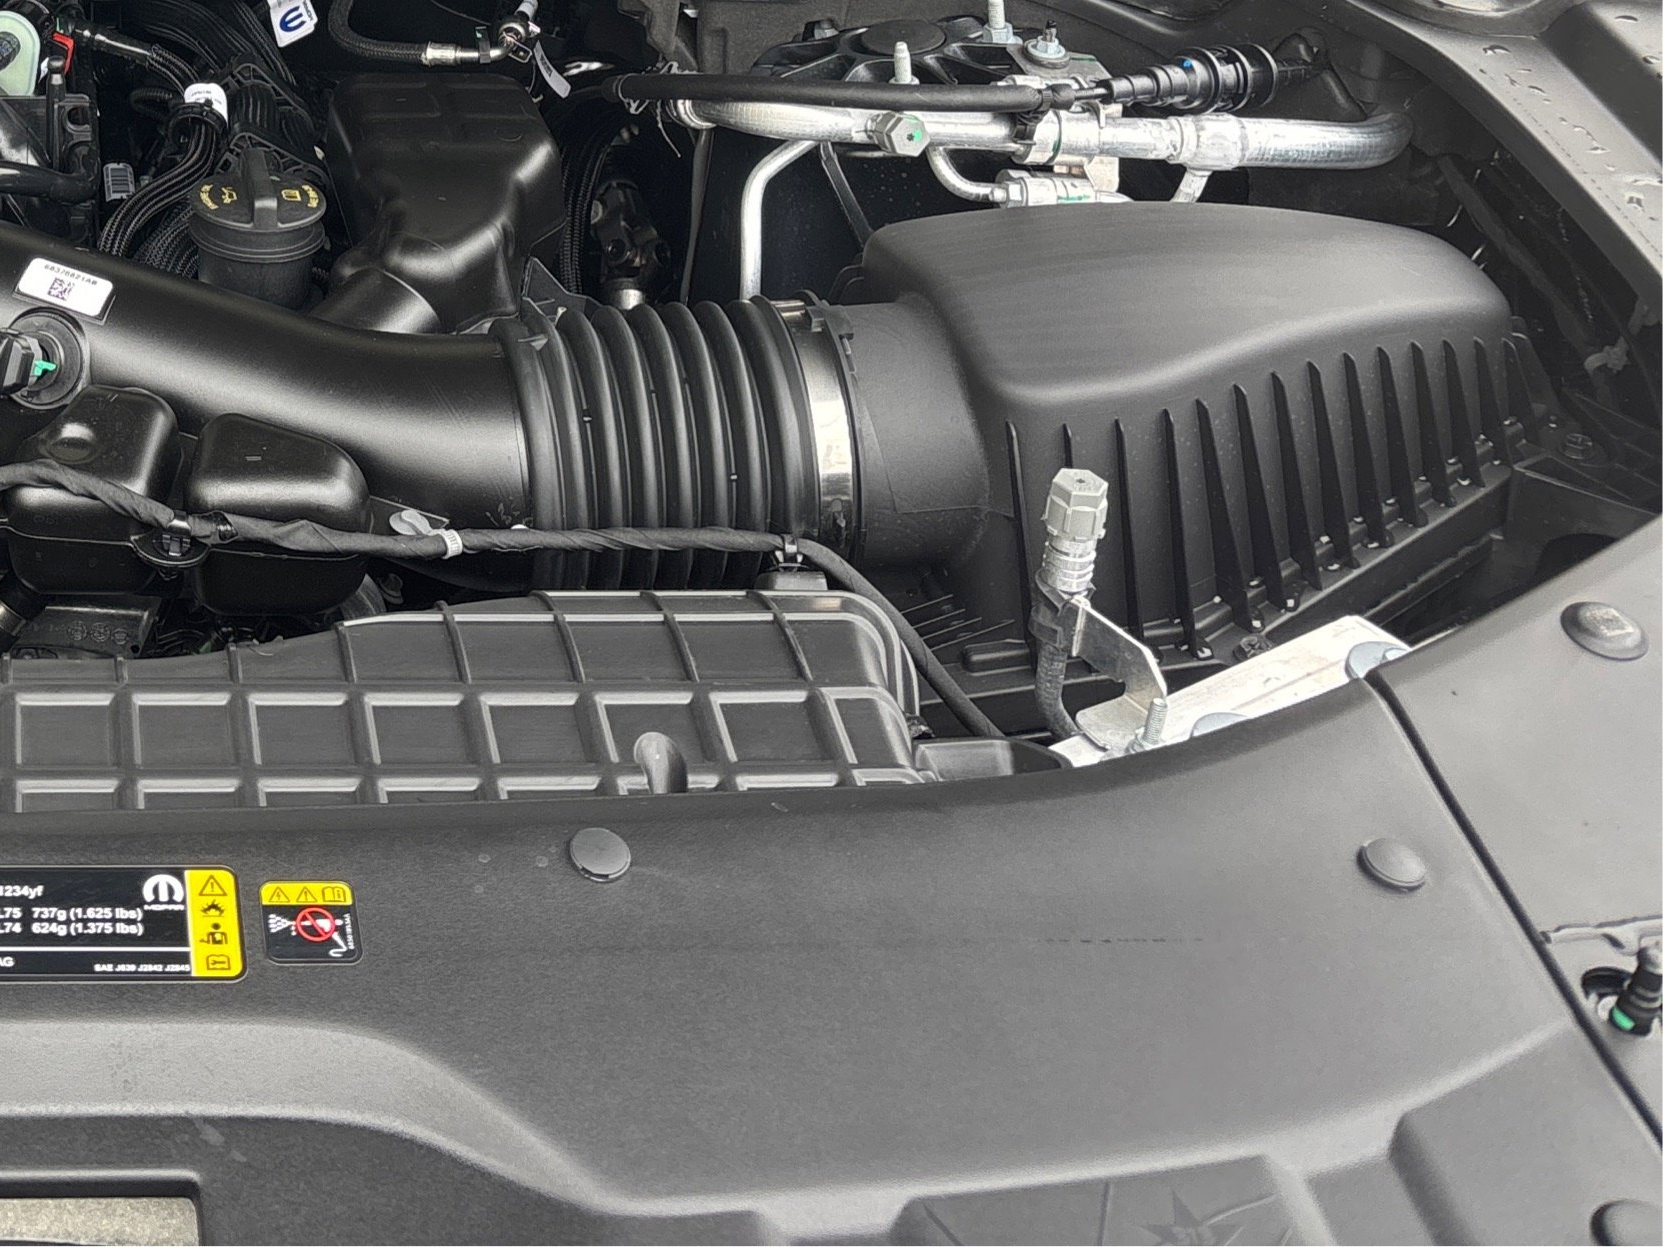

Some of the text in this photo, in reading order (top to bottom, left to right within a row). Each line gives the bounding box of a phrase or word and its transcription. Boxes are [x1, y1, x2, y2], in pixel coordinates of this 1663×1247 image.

[32, 907, 67, 921] 737g
[69, 907, 113, 921] (1.625
[115, 907, 143, 921] lbs)
[32, 922, 67, 936] 624g
[69, 922, 113, 936] (1.375
[115, 922, 144, 936] lbs)
